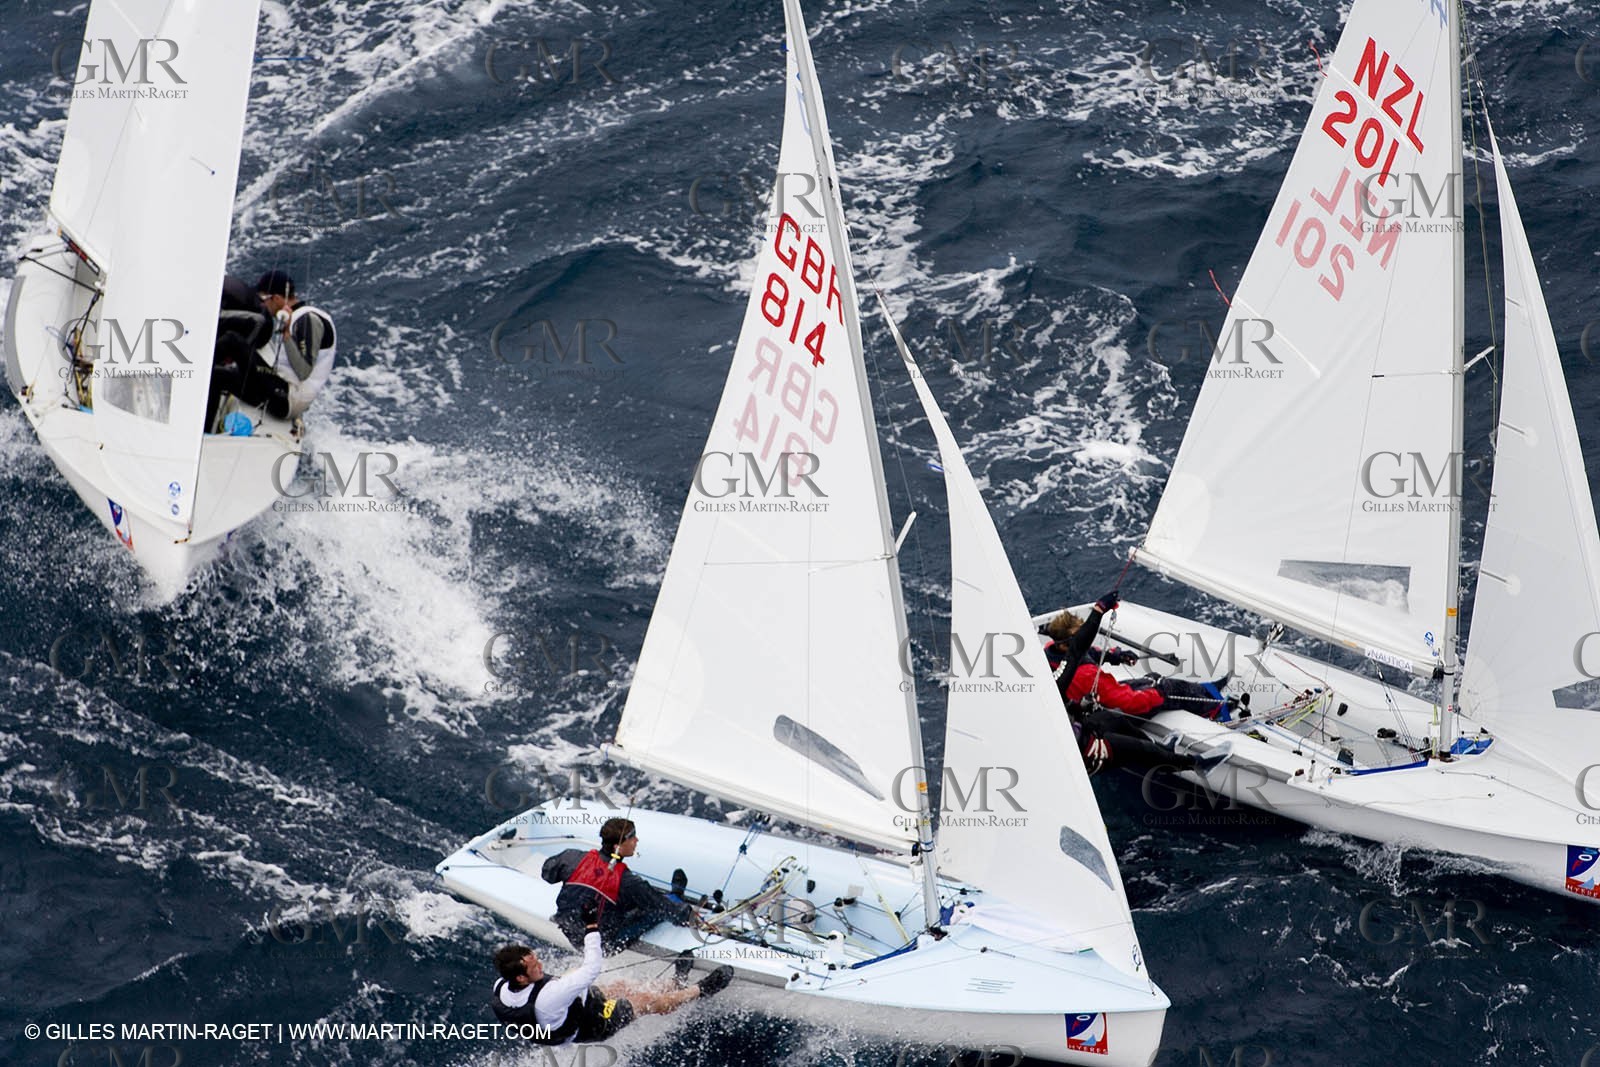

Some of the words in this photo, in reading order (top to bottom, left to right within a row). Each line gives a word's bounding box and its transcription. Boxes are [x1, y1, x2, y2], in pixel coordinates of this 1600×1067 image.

[1321, 91, 1399, 187] 201
[1353, 37, 1424, 154] NZL
[761, 272, 826, 368] 814
